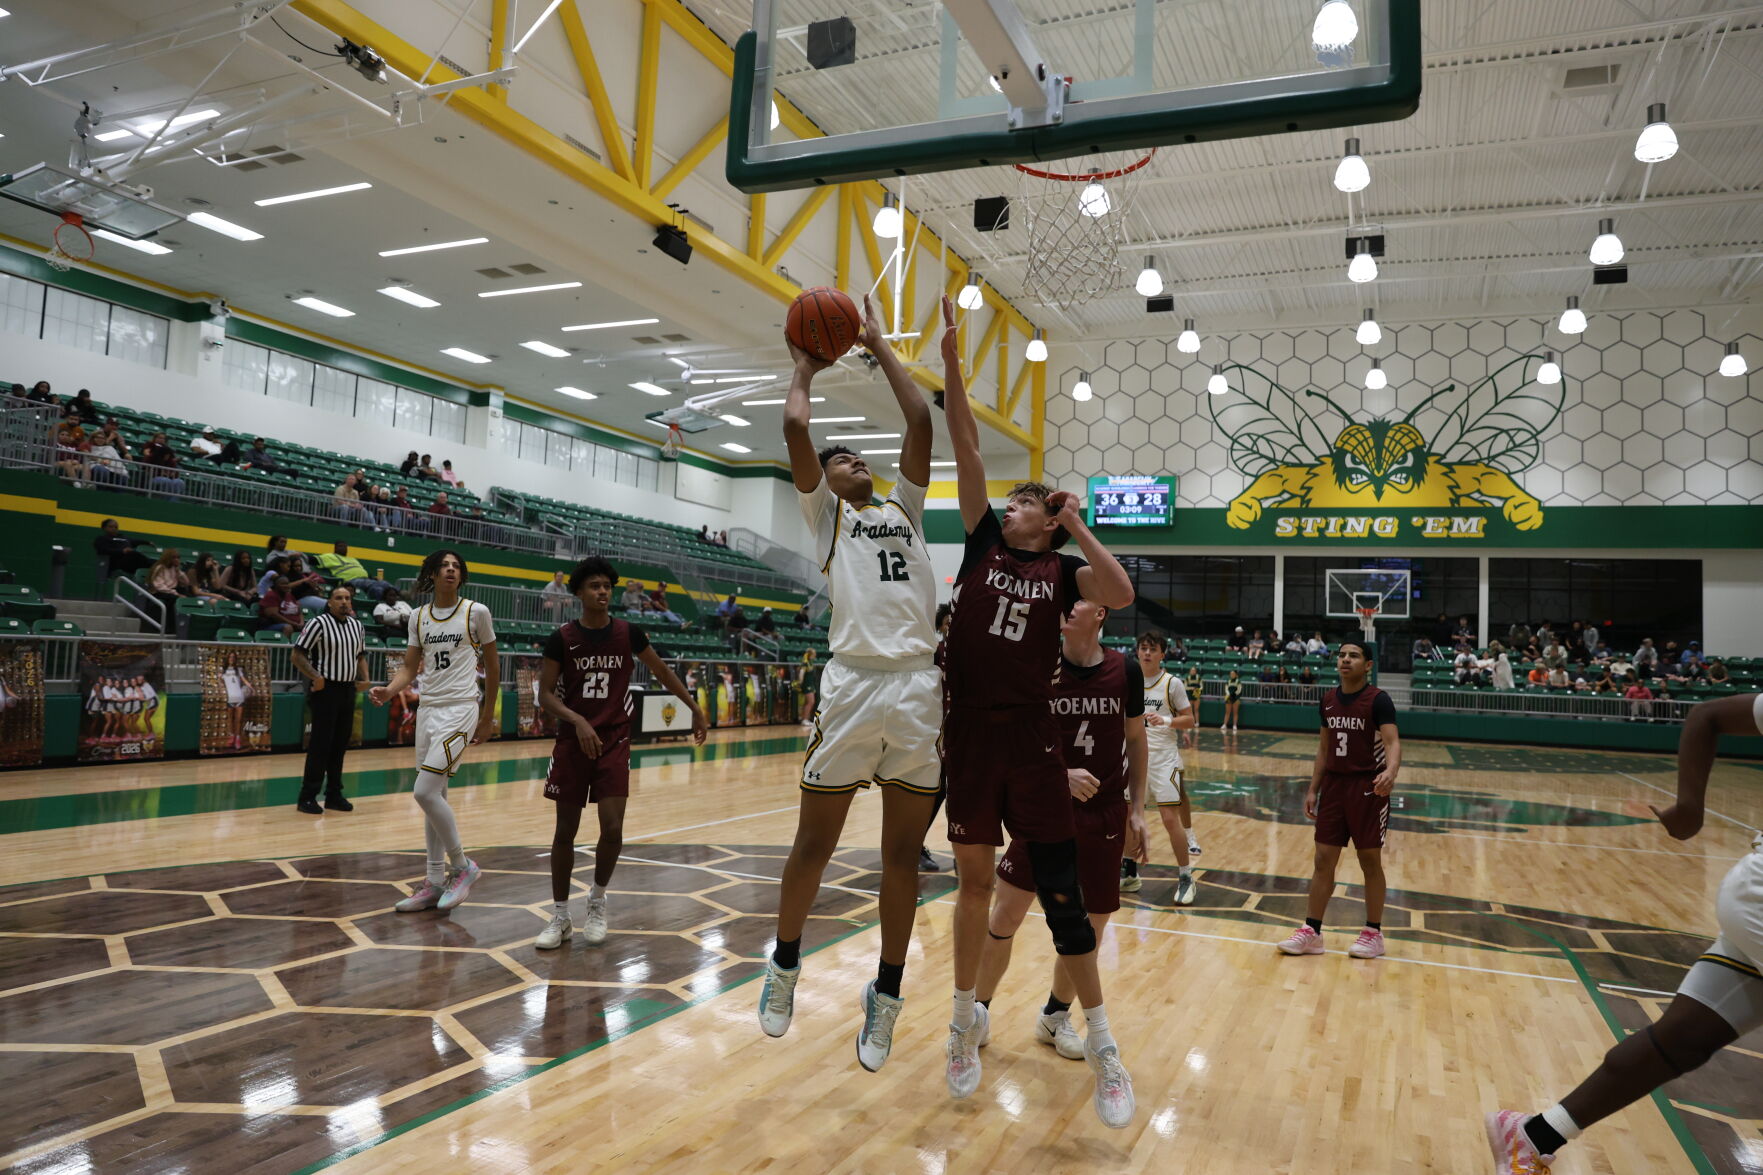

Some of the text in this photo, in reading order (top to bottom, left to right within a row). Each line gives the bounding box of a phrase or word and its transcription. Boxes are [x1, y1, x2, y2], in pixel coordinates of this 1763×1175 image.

[1101, 493, 1119, 506] 36
[1144, 493, 1162, 506] 28
[1120, 505, 1142, 513] 03:09
[850, 520, 912, 547] Academy
[1275, 516, 1488, 538] STING 'EM
[877, 549, 910, 581] 12
[988, 595, 1031, 641] 15
[424, 632, 463, 648] Academy
[434, 651, 451, 670] 15
[573, 655, 624, 671] YOEMEN
[582, 672, 609, 699] 23
[1049, 698, 1121, 715] YOEMEN
[1144, 697, 1163, 711] demy
[1073, 720, 1095, 755] 4
[1336, 732, 1348, 757] 3
[121, 743, 140, 754] 2026
